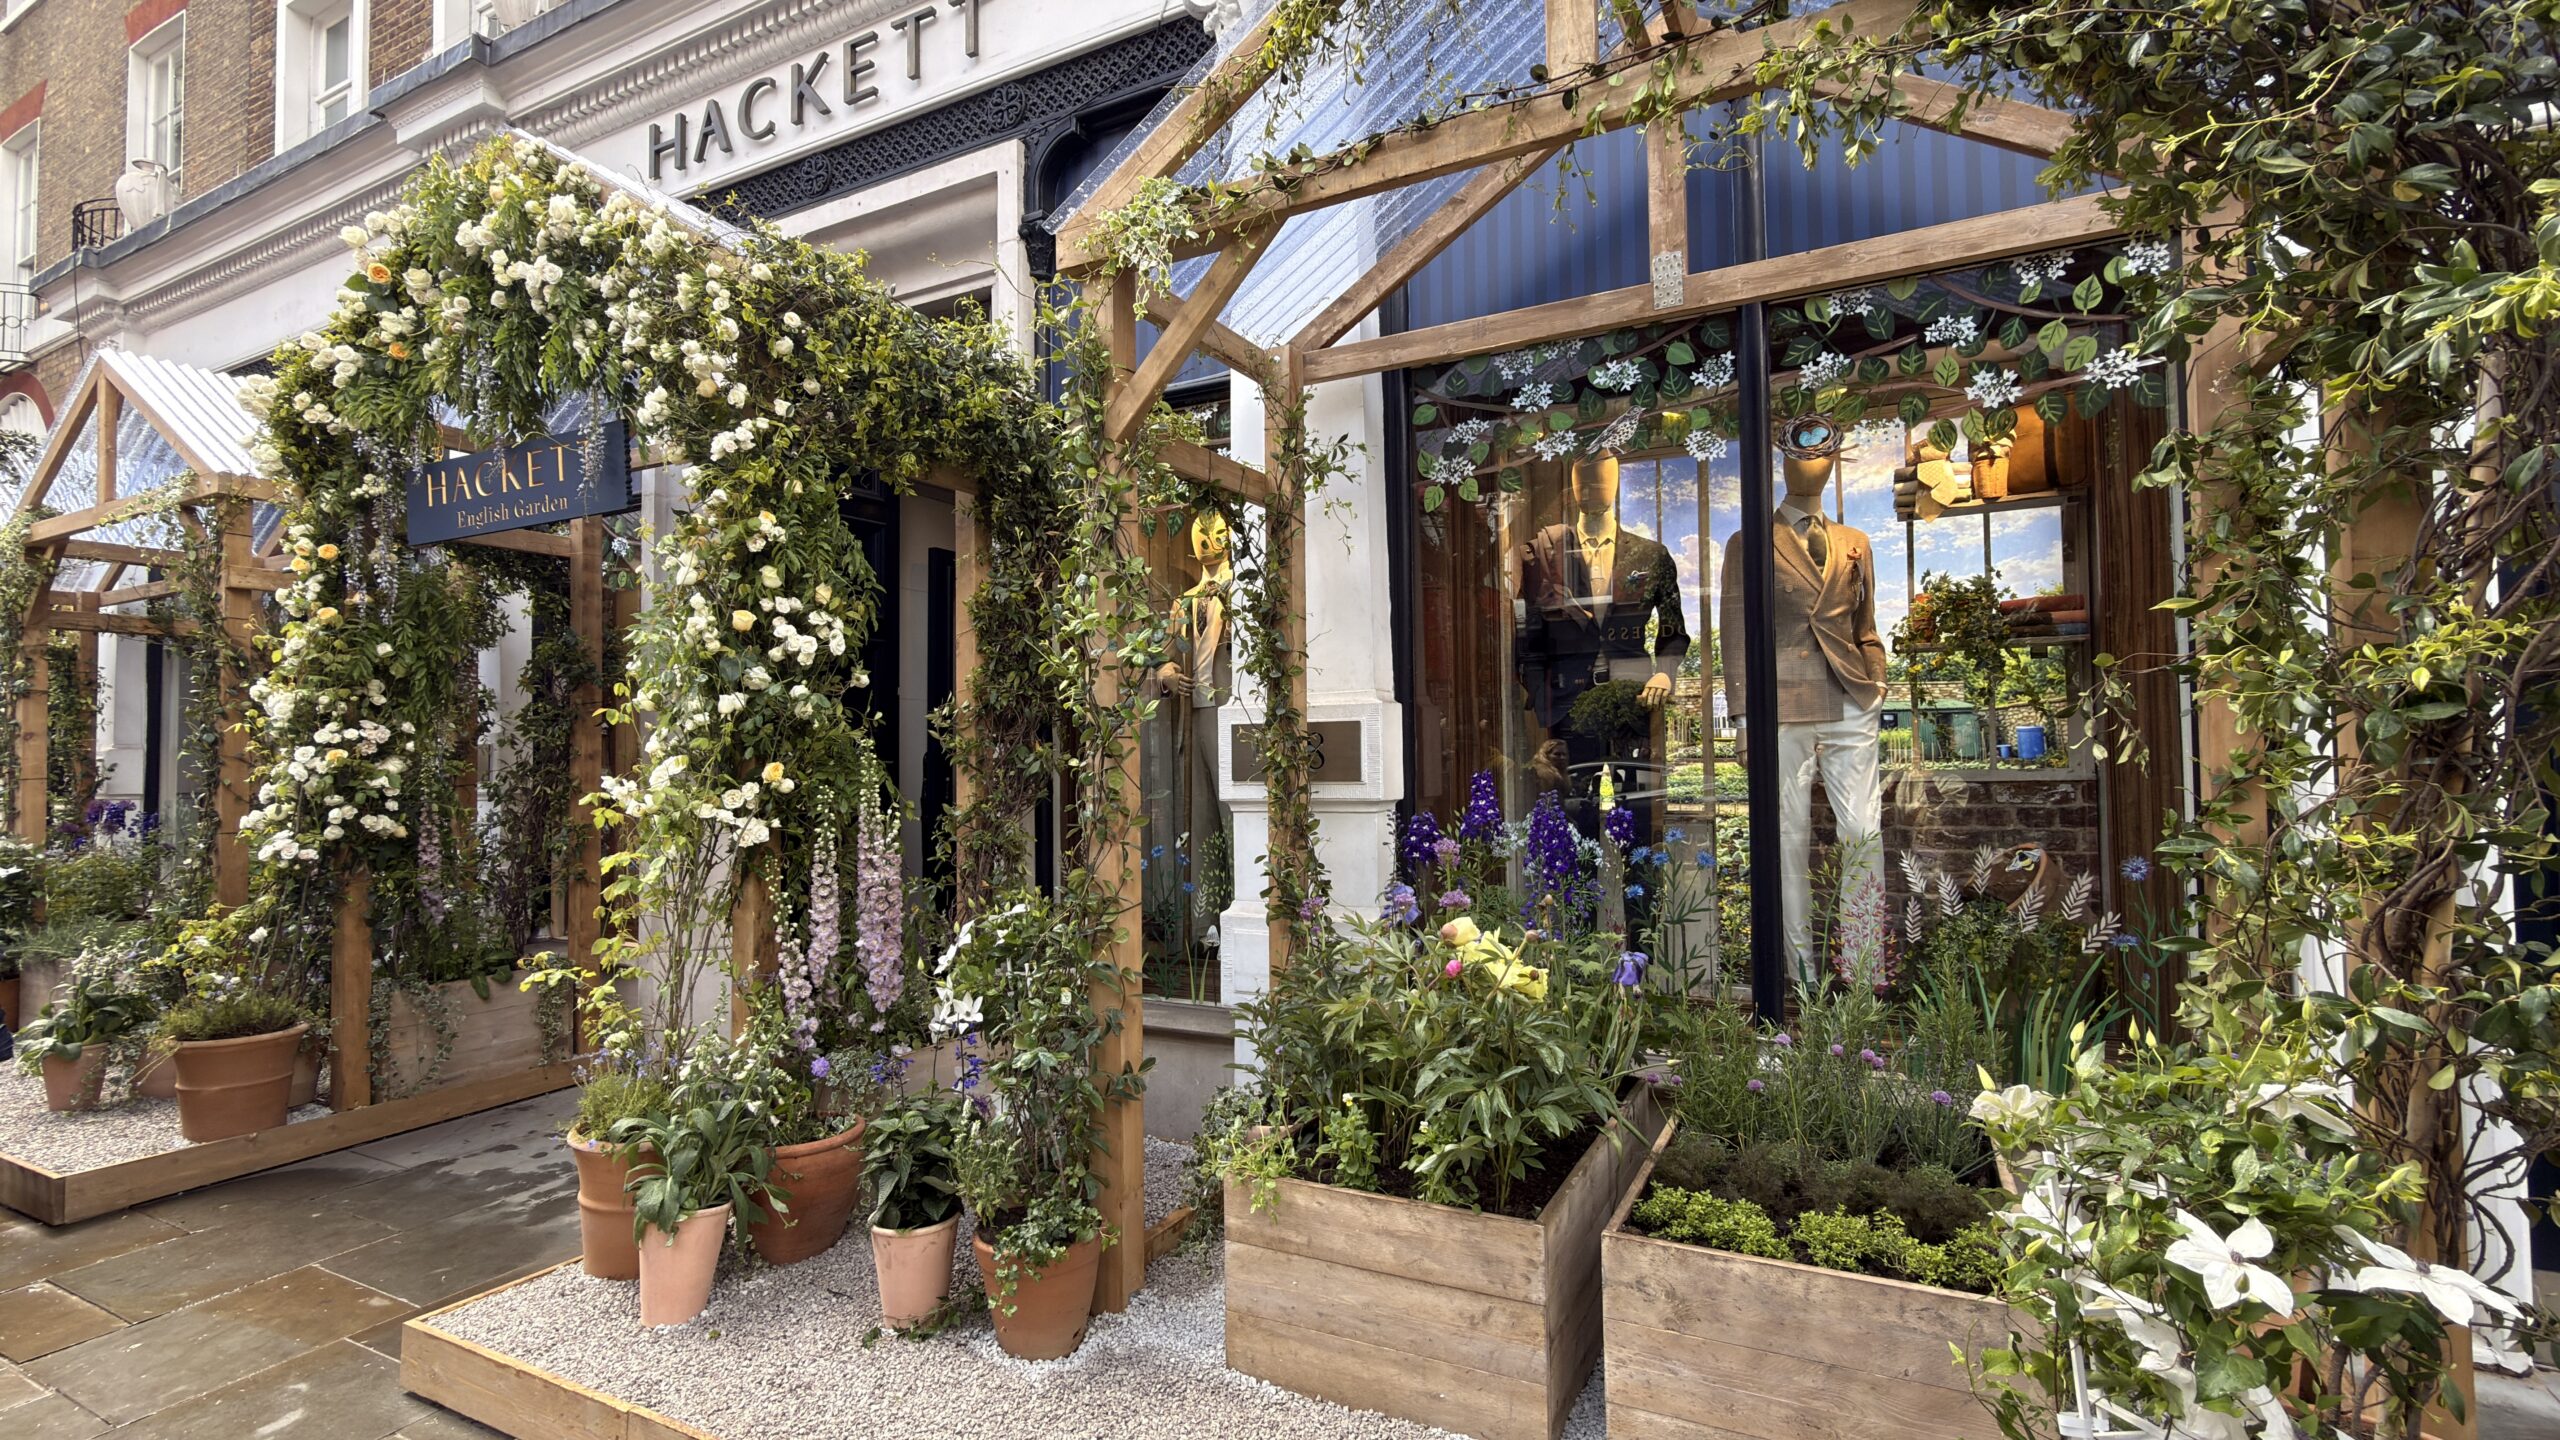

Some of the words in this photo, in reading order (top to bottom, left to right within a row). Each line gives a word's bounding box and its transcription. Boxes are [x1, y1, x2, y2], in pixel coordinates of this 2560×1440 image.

[648, 0, 980, 180] HACKETT
[427, 440, 592, 507] HACKETT
[457, 503, 509, 529] English
[513, 494, 569, 518] Garden
